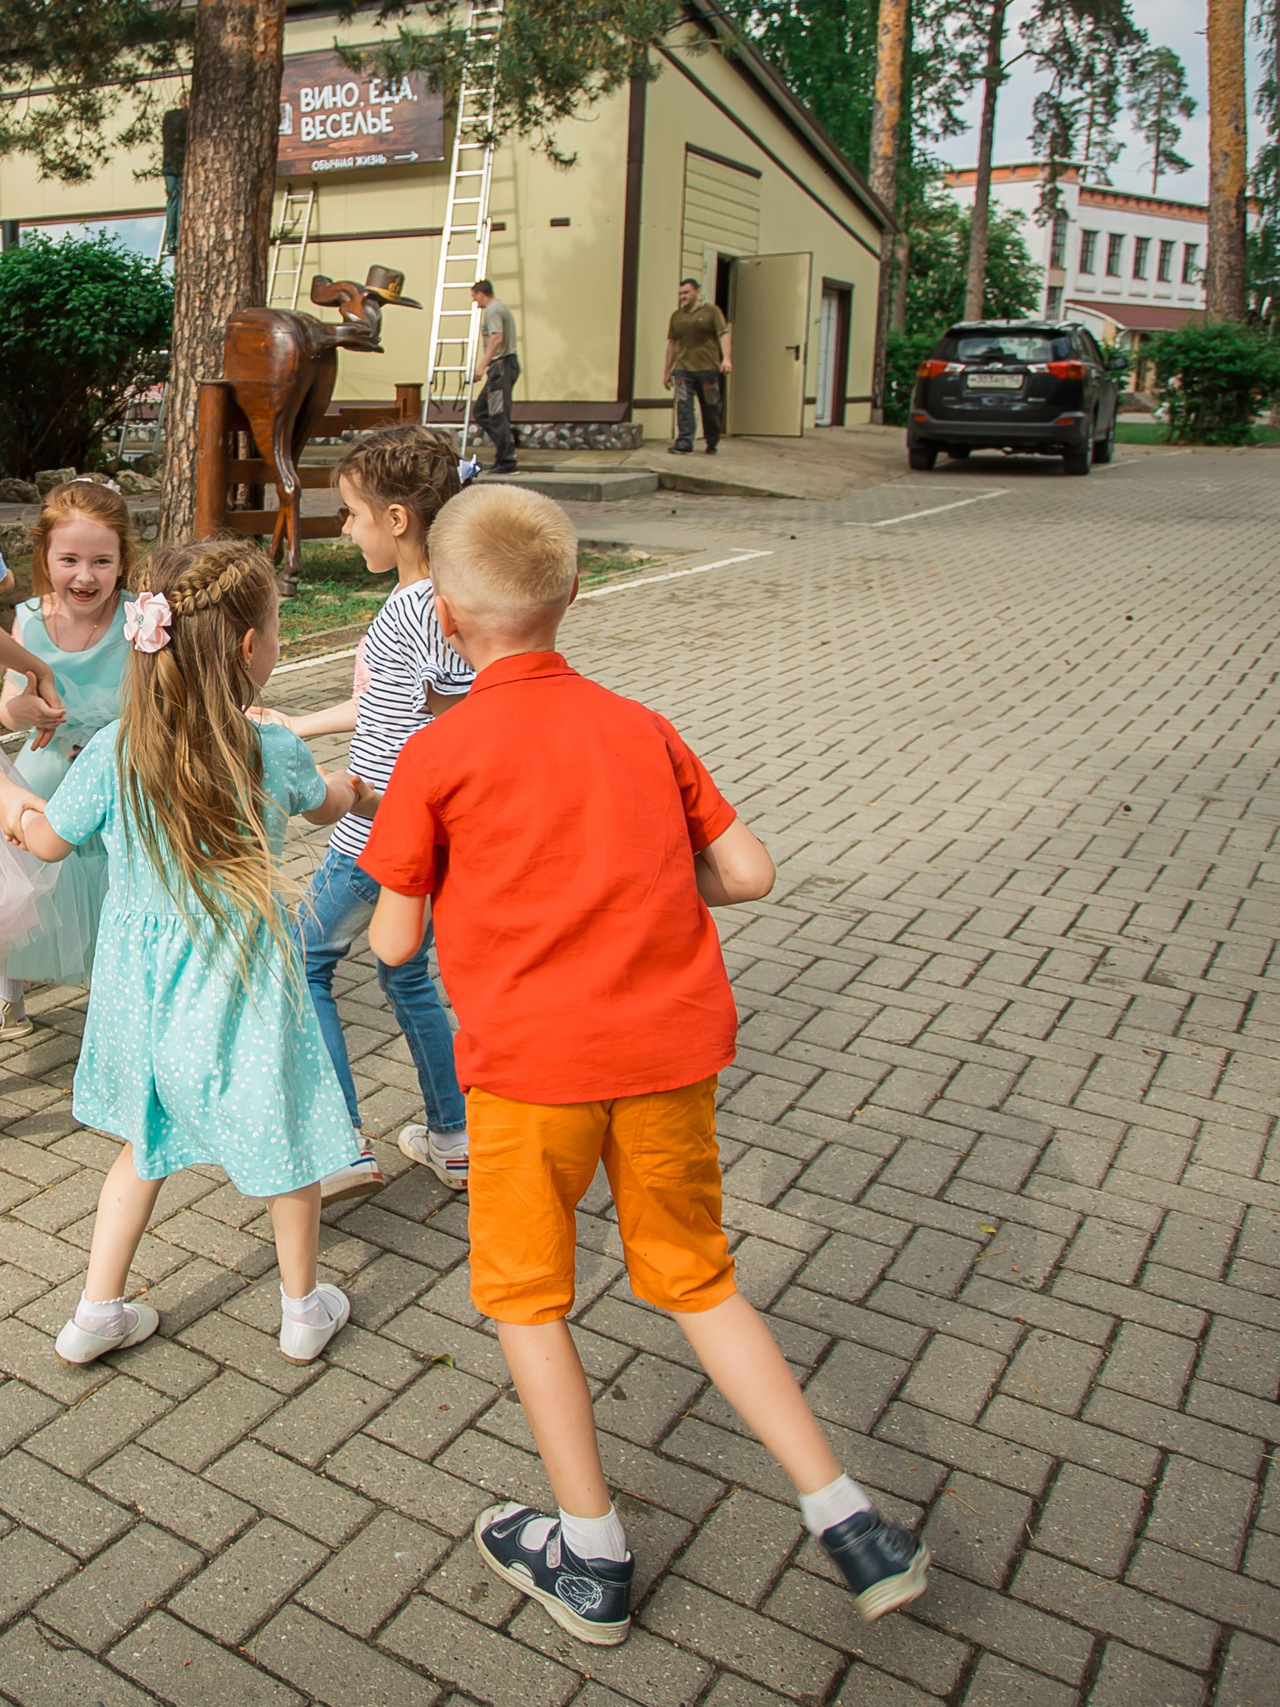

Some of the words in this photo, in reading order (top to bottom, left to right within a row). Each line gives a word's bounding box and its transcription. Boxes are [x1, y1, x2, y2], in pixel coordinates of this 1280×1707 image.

[300, 107, 394, 142] ВЕСЕЛЬЕ
[312, 156, 354, 171] ОБЫЧНАЯ
[355, 154, 387, 167] ЖИЗНЬ
